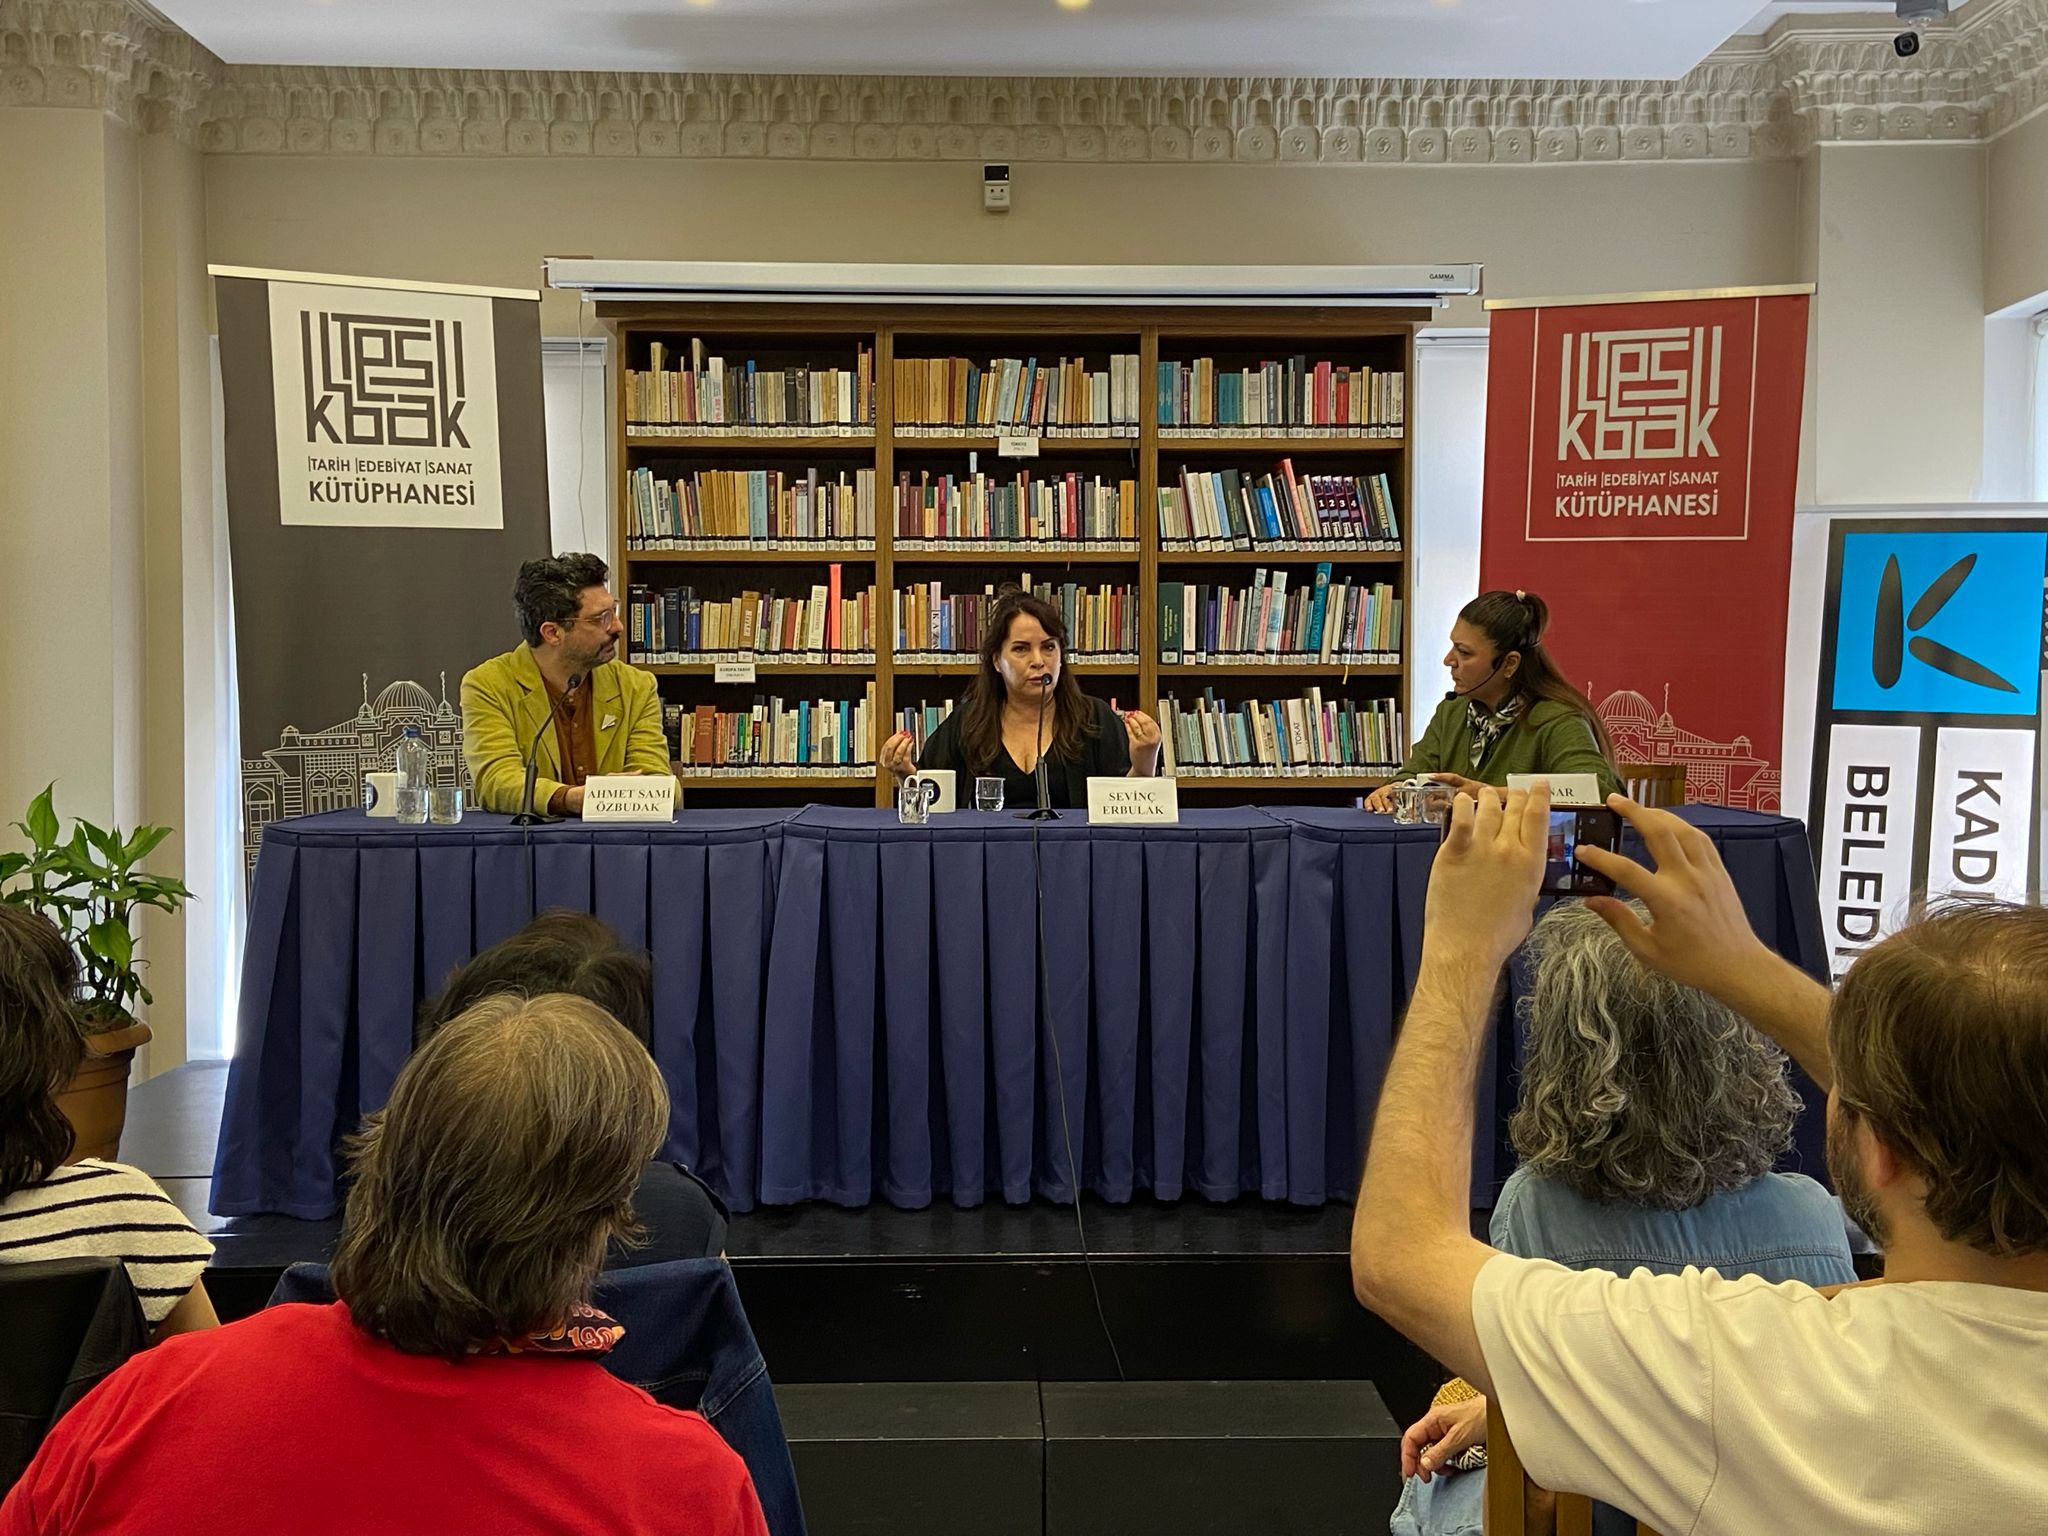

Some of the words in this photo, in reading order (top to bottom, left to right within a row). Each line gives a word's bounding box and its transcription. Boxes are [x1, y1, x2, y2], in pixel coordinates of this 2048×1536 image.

[311, 457, 350, 472] TARİH
[358, 458, 421, 474] EDEBİYAT
[428, 462, 473, 475] SANAT
[1560, 472, 1597, 487] TARİH
[1604, 471, 1666, 486] EDEBİYAT
[1672, 472, 1719, 485] SANAT
[309, 477, 475, 506] KÜTÜPHANESİ
[1555, 489, 1719, 517] KÜTÜPHANESİ
[588, 789, 635, 798] AHMET
[638, 787, 671, 799] SAMİ
[1109, 790, 1157, 803] SEVİNÇ
[596, 801, 659, 812] ÖZBUDAK
[1103, 805, 1164, 815] ERBULAK
